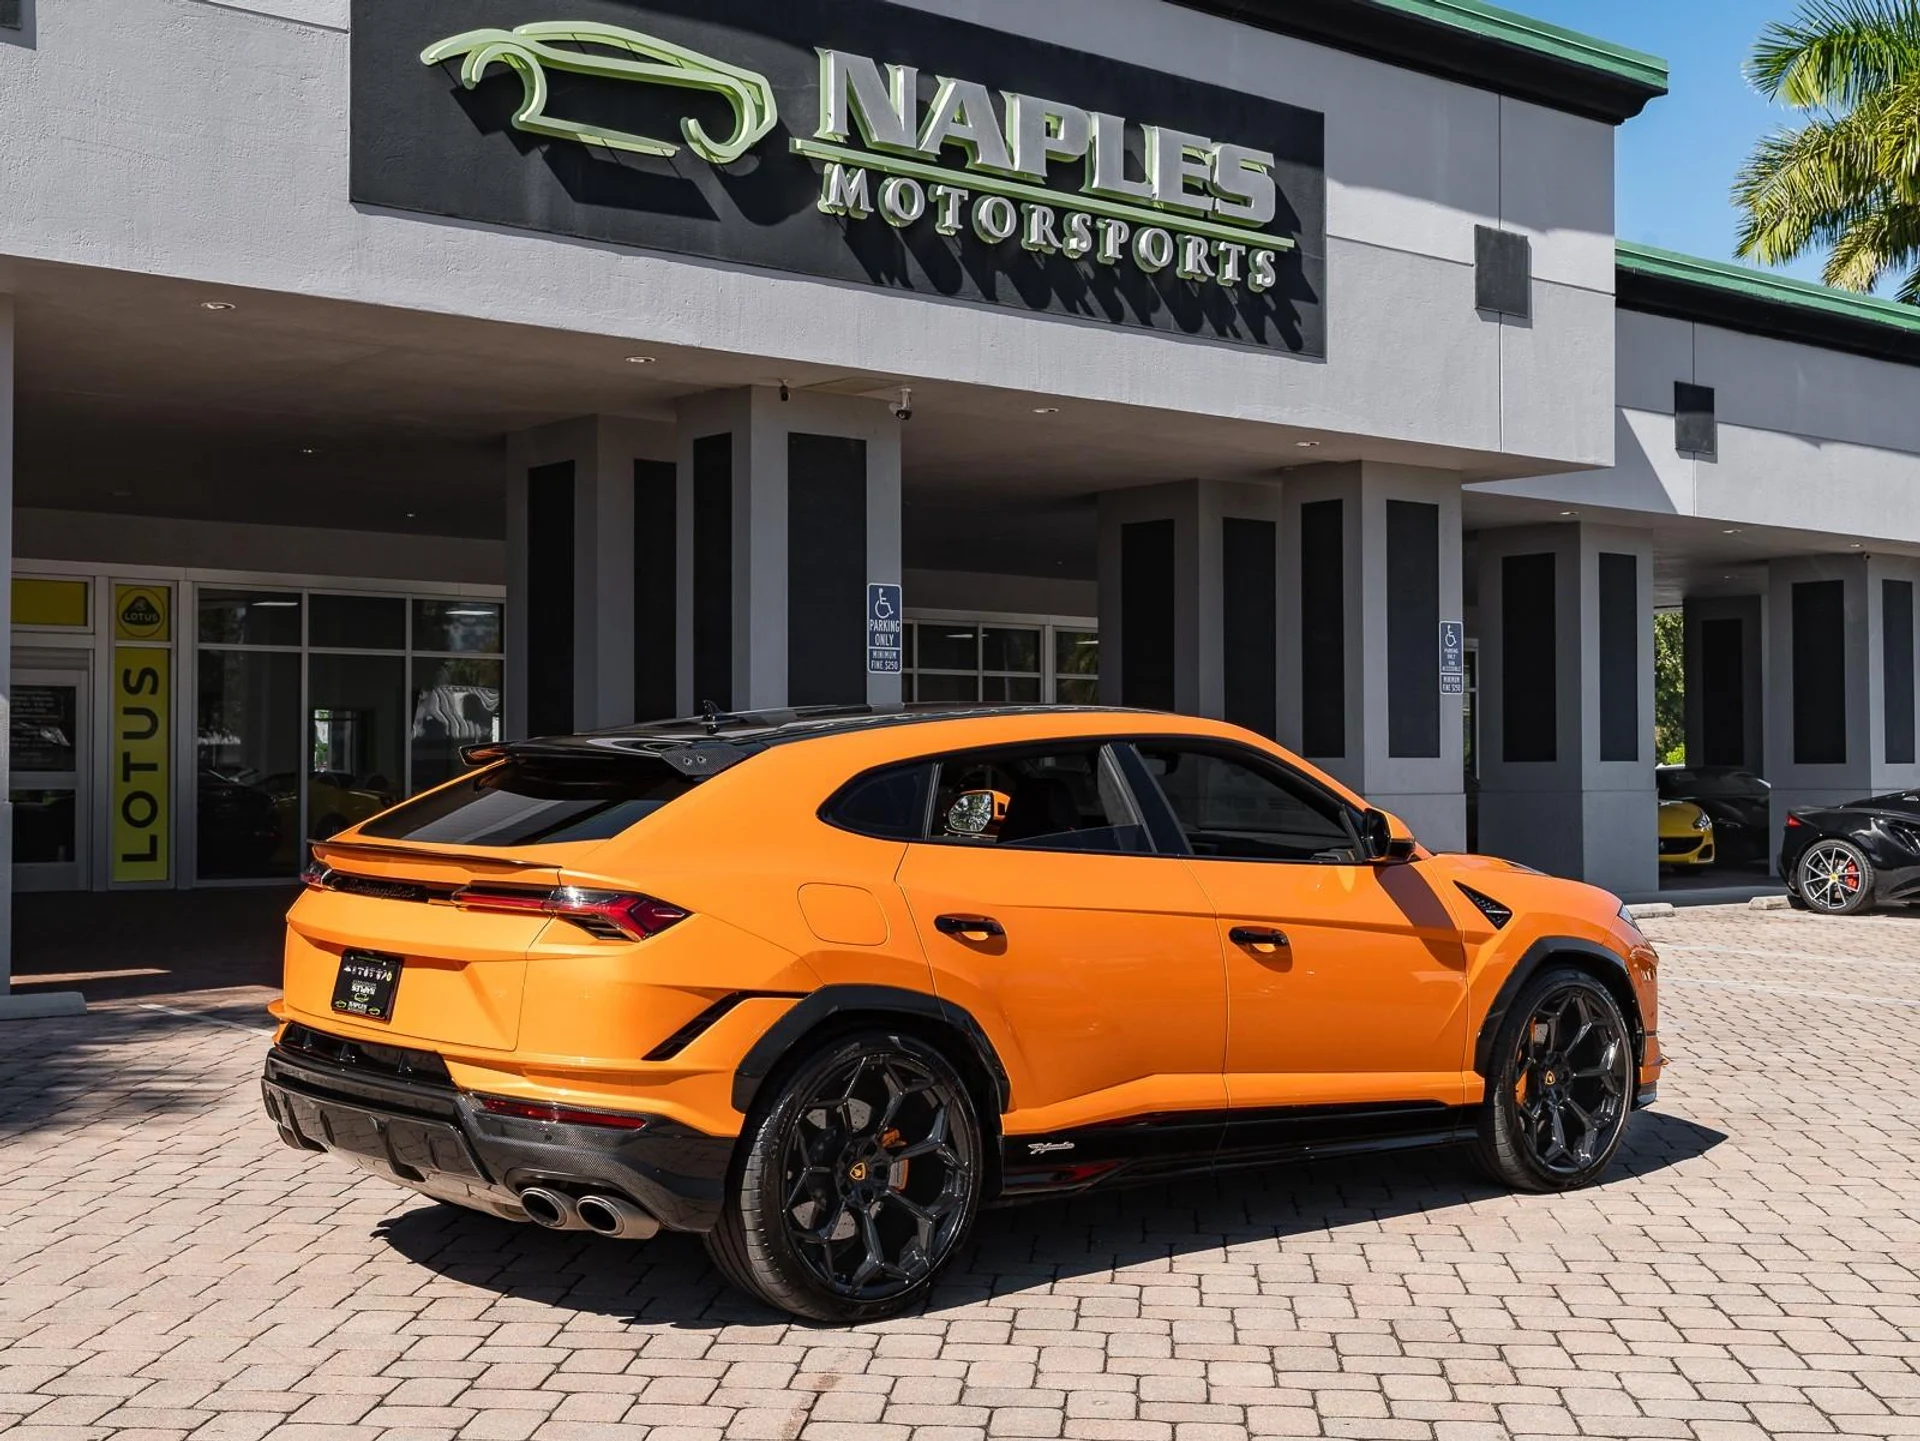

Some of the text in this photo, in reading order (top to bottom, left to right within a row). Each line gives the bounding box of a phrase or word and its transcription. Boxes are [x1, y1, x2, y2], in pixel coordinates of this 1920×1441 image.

[815, 47, 1276, 227] NAPLES
[819, 163, 1276, 291] MOTORSPORTS
[124, 612, 158, 621] LOTUS
[869, 619, 900, 633] PARKING
[874, 633, 894, 646] ONLY
[872, 650, 897, 660] MINIMUM
[871, 660, 899, 671] FINE $250
[122, 667, 159, 862] LOTUS
